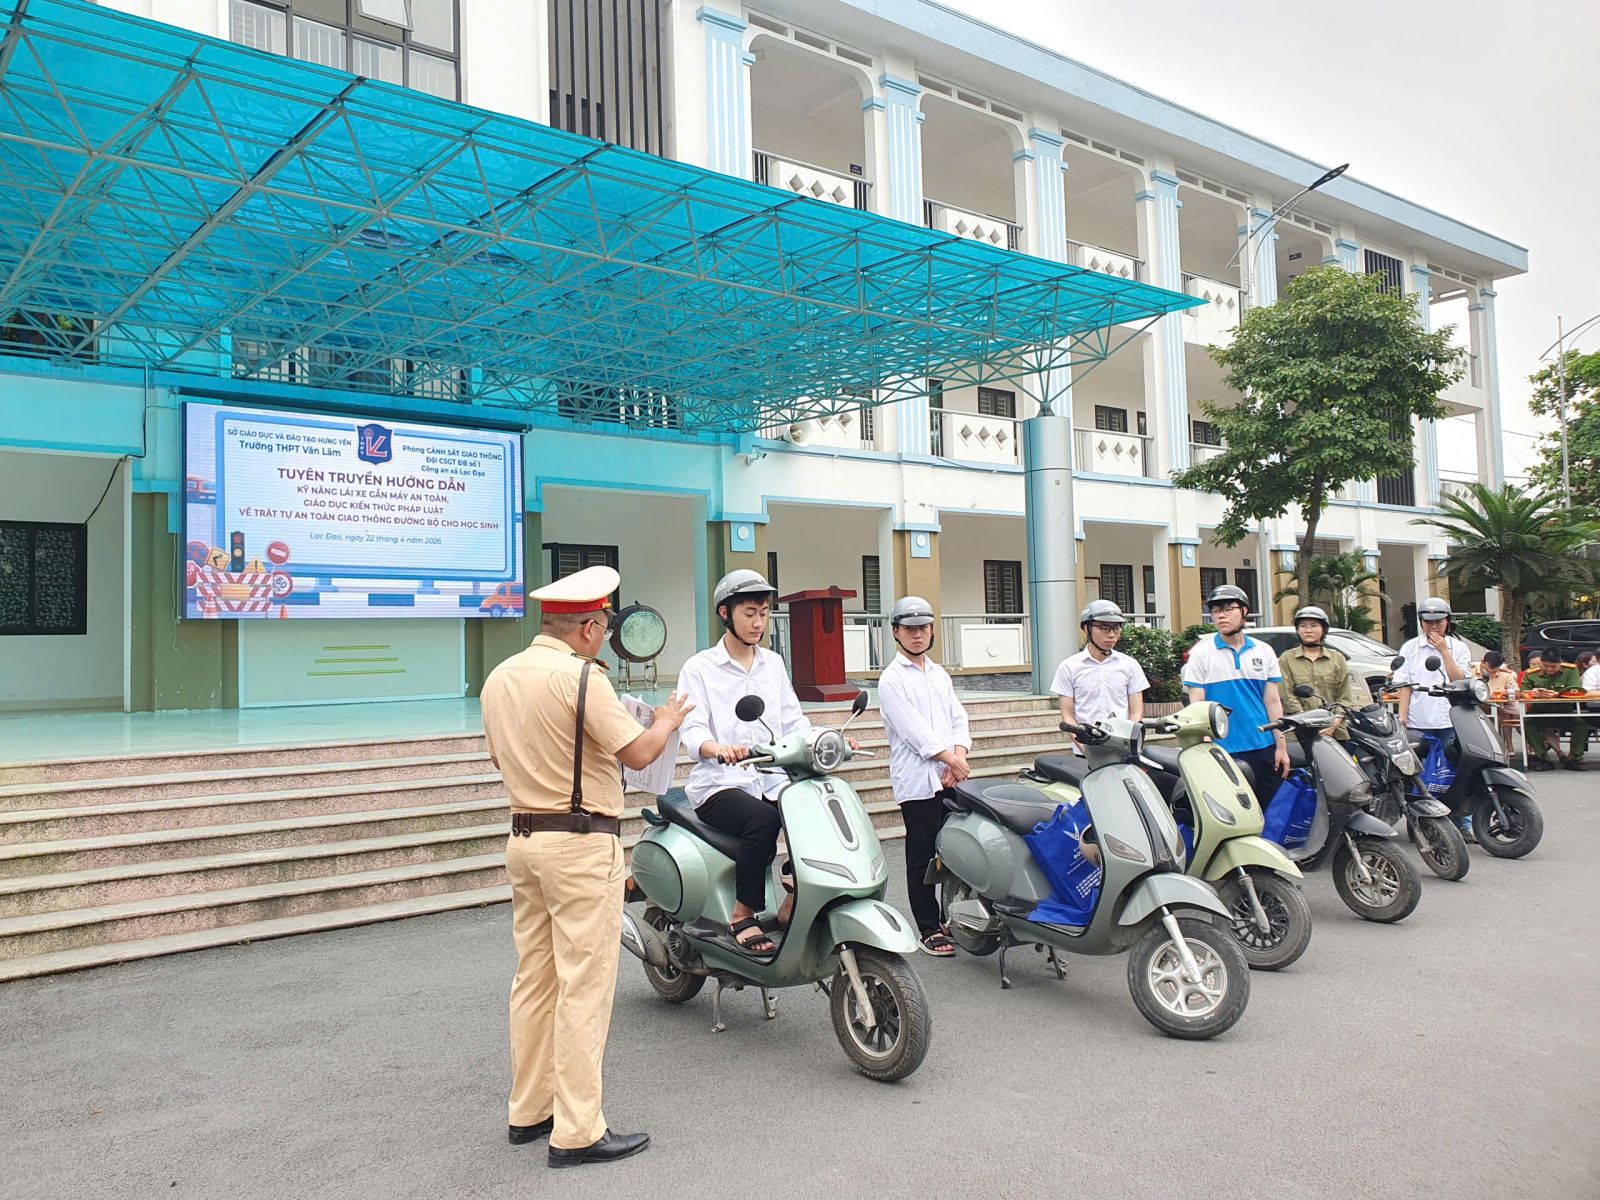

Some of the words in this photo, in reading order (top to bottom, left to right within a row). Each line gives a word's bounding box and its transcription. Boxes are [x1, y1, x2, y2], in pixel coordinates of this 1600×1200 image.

[260, 432, 273, 440] DỤC
[276, 432, 284, 440] VÀ
[286, 433, 301, 441] ĐÀO
[318, 436, 336, 444] HƯNG
[339, 438, 351, 446] YÊN
[239, 440, 273, 452] Trường
[276, 444, 300, 453] THPT
[302, 446, 319, 455] Văn
[322, 447, 341, 456] Lâm
[403, 445, 424, 454] Phòng
[427, 446, 445, 455] CẢNH
[448, 448, 459, 456] SÁT
[480, 452, 502, 460] THÔNG
[426, 456, 437, 465] Đội
[422, 466, 438, 474] Công
[277, 467, 324, 482] TUYÊN
[328, 471, 382, 486] TRUYỀN
[387, 475, 434, 489] HƯỚNG
[438, 477, 465, 492] DẪN
[297, 485, 309, 494] KỸ
[312, 486, 337, 496] NĂNG
[390, 491, 408, 500] MÁY
[425, 494, 449, 504] TOÀN,
[304, 499, 326, 507] GIÁO
[329, 501, 347, 510] DỤC
[350, 501, 370, 510] KIẾN
[372, 503, 395, 512] THỨC
[398, 504, 421, 513] PHÁP
[424, 507, 444, 516] LUẬT
[239, 507, 251, 516] VỀ
[254, 508, 277, 518] TRẬT
[280, 510, 292, 520] TỰ
[310, 512, 335, 521] TOÀN
[362, 515, 391, 524] THÔNG
[394, 516, 425, 525] ĐƯỜNG
[428, 518, 439, 528] BỘ
[461, 521, 478, 530] HỌC
[345, 534, 363, 543] ngày
[376, 535, 398, 544] tháng
